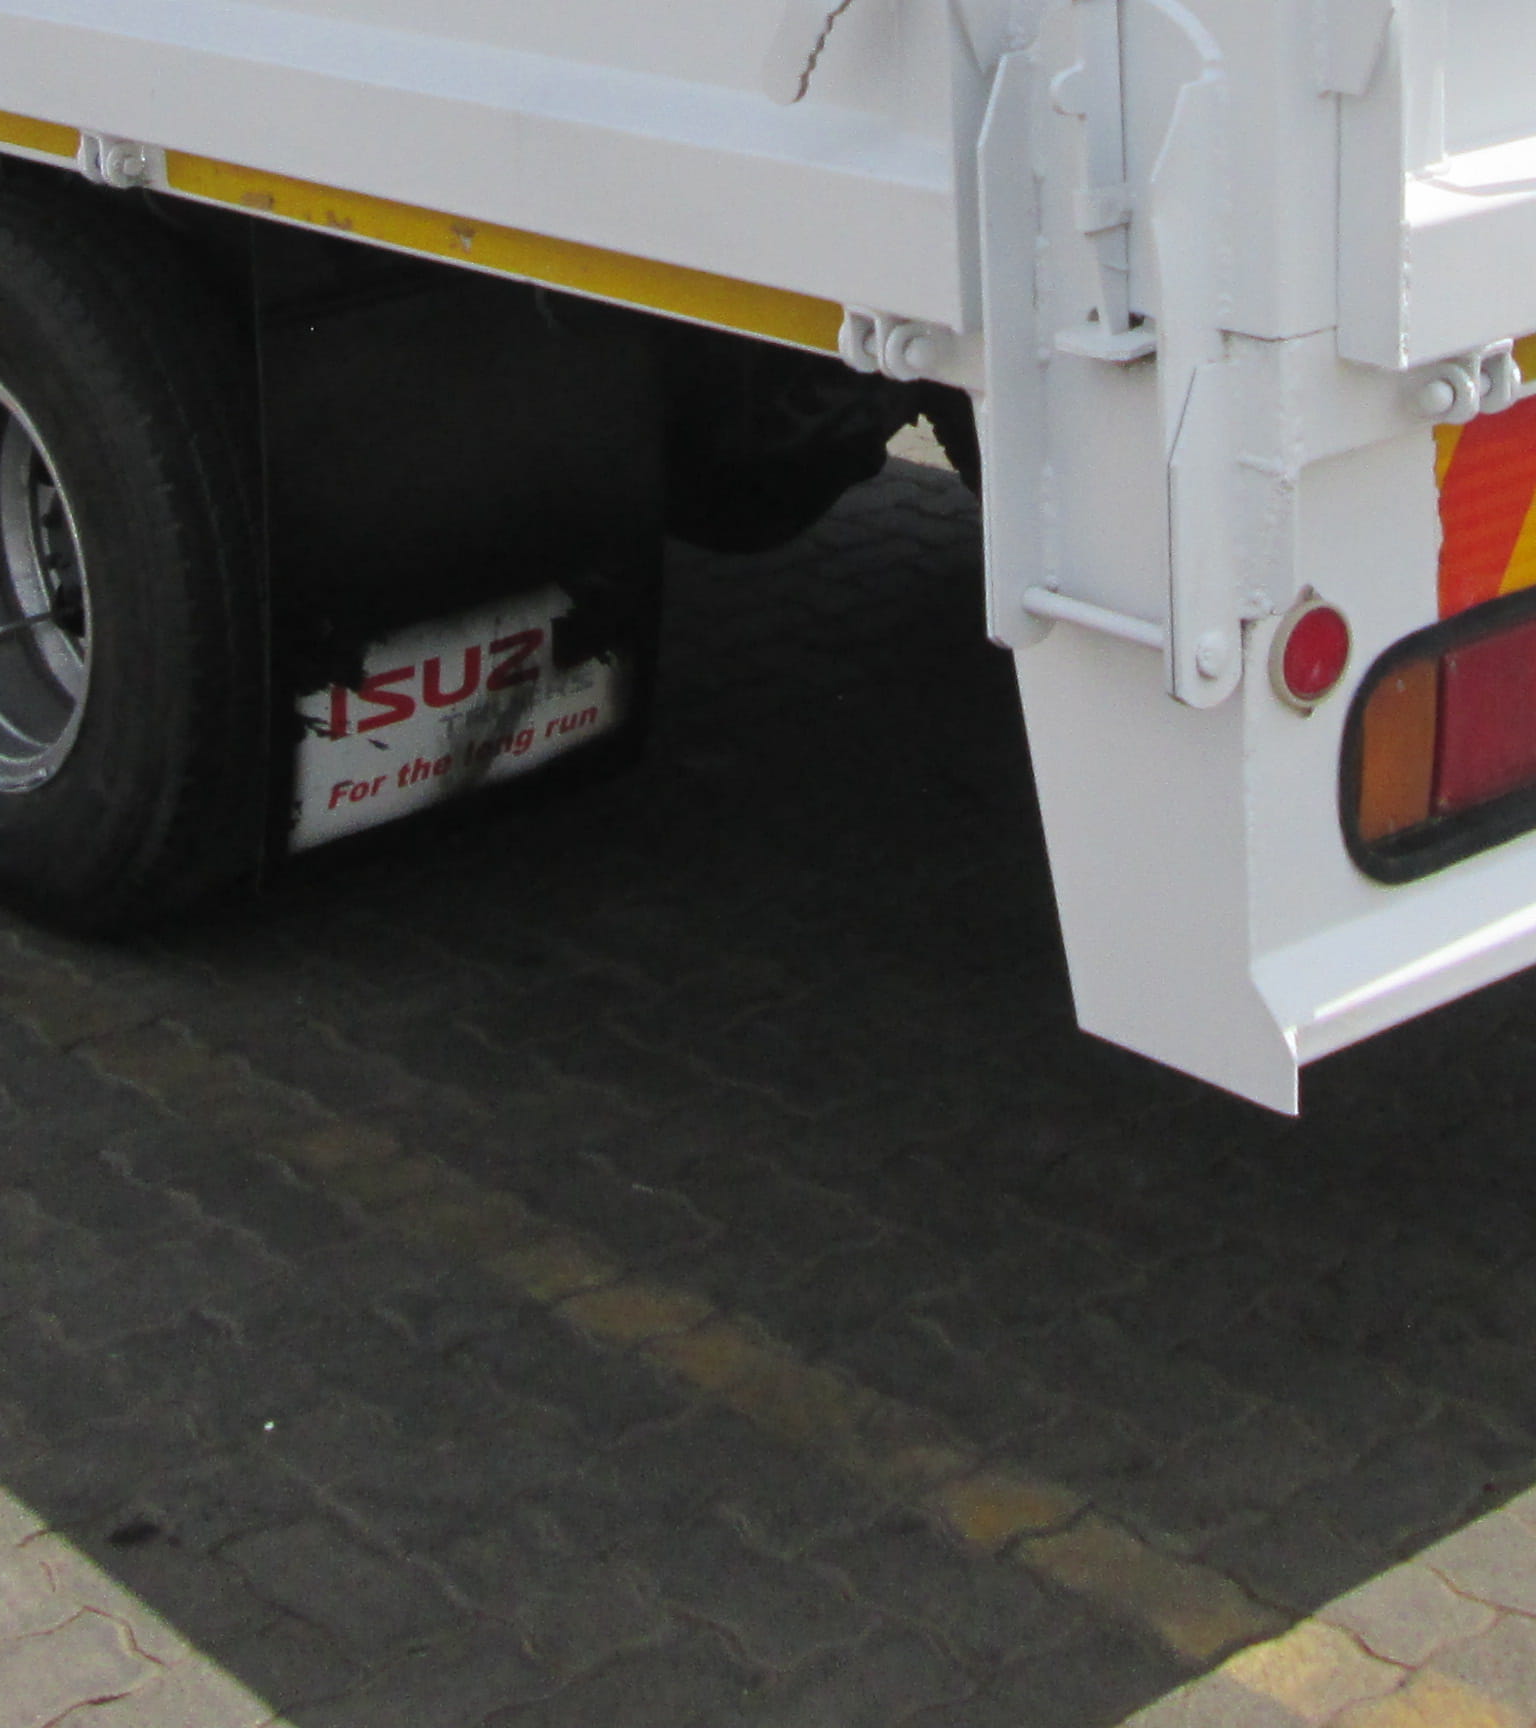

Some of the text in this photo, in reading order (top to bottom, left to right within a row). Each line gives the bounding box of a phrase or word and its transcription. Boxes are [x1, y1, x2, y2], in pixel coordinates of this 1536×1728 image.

[330, 627, 592, 741] ISUZ
[328, 775, 386, 809] For
[397, 754, 452, 788] the
[544, 707, 599, 738] run
